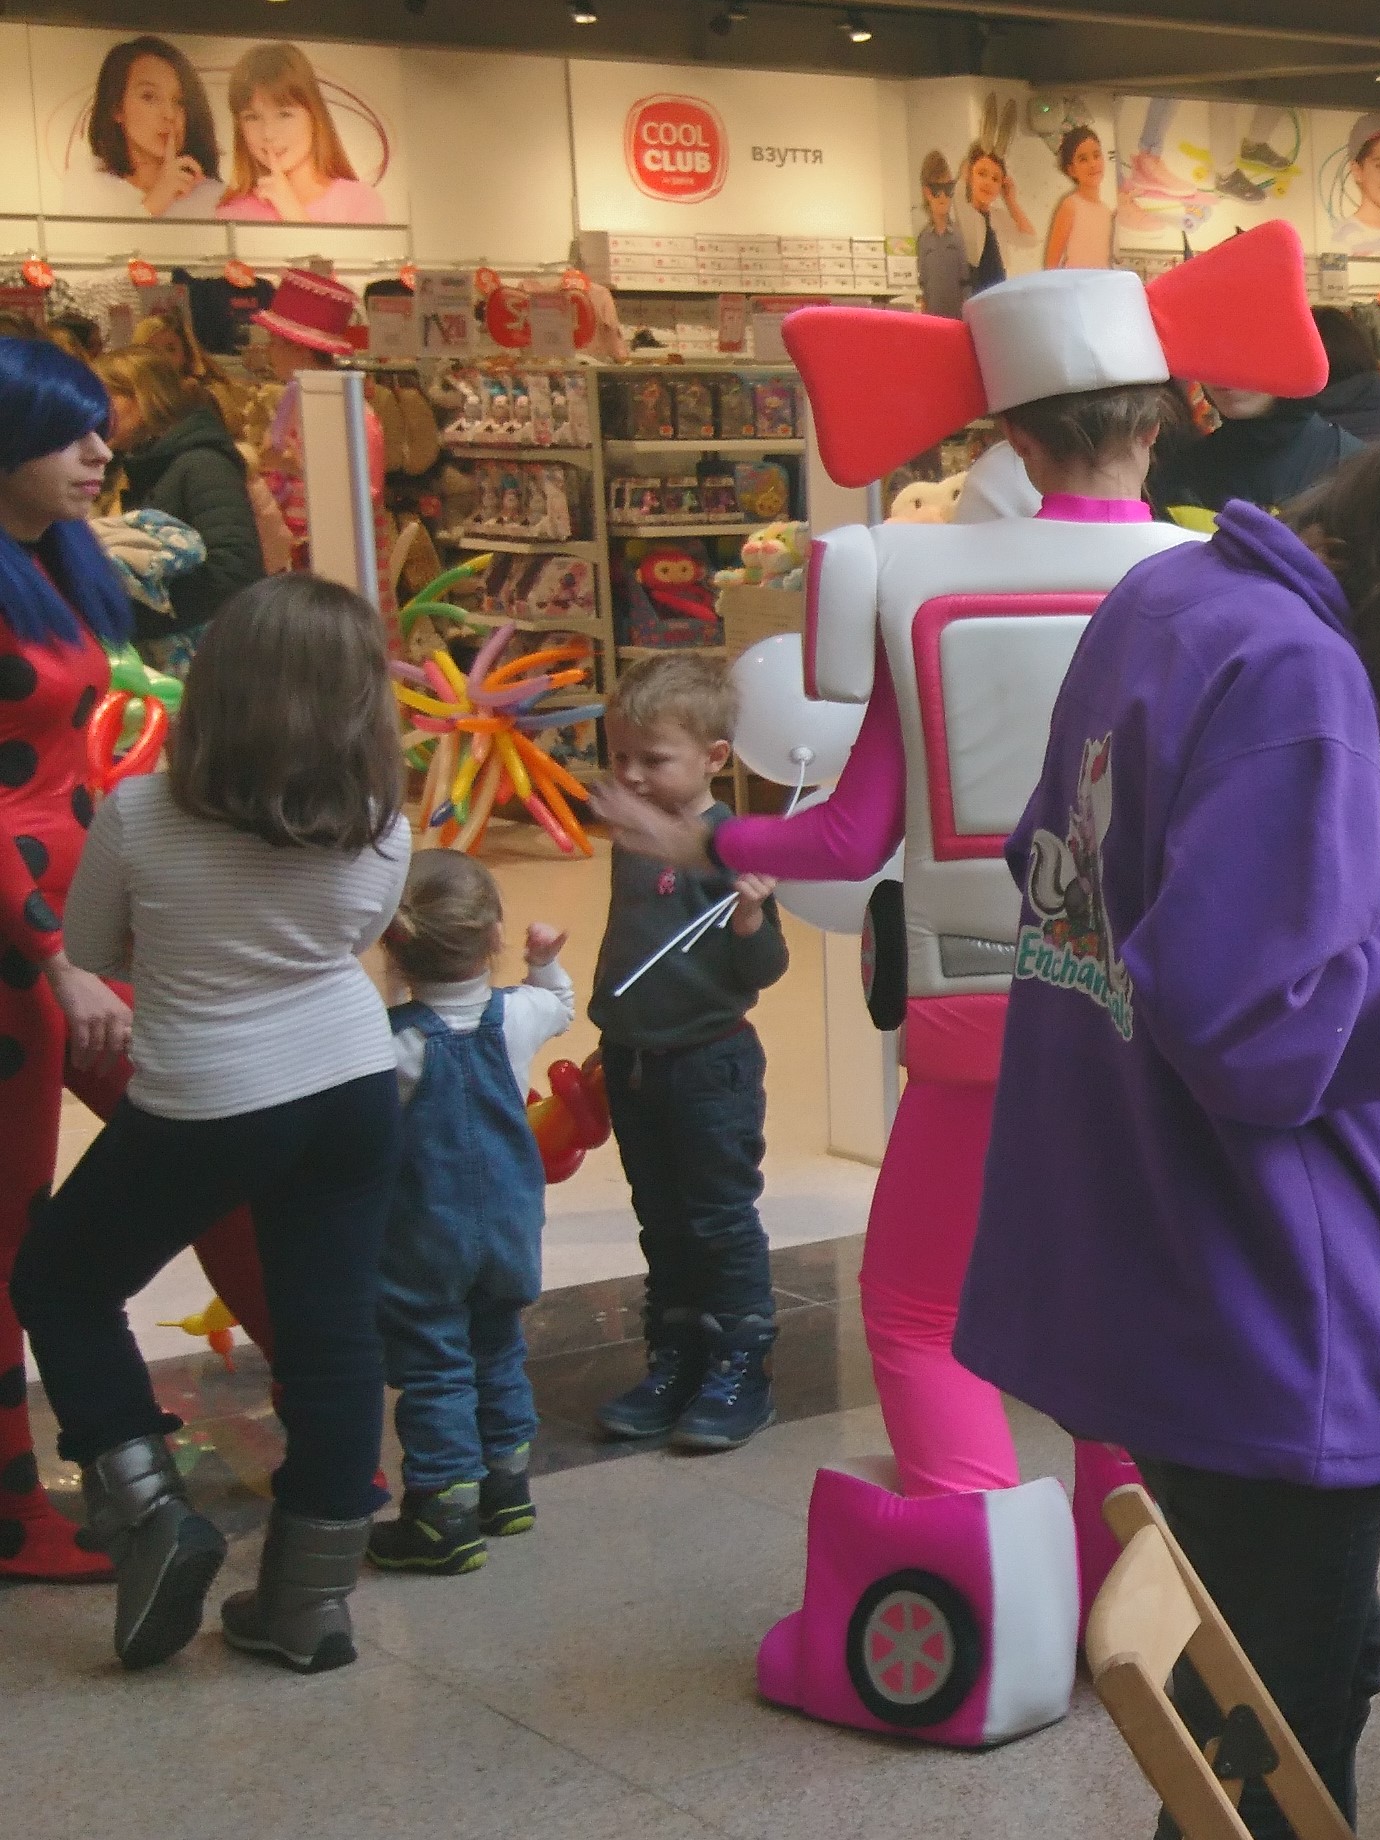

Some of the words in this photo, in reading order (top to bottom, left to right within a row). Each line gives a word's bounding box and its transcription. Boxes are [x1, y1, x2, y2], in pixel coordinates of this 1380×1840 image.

[642, 121, 710, 147] COOL
[643, 149, 712, 174] CLUB
[751, 145, 823, 168] взуття
